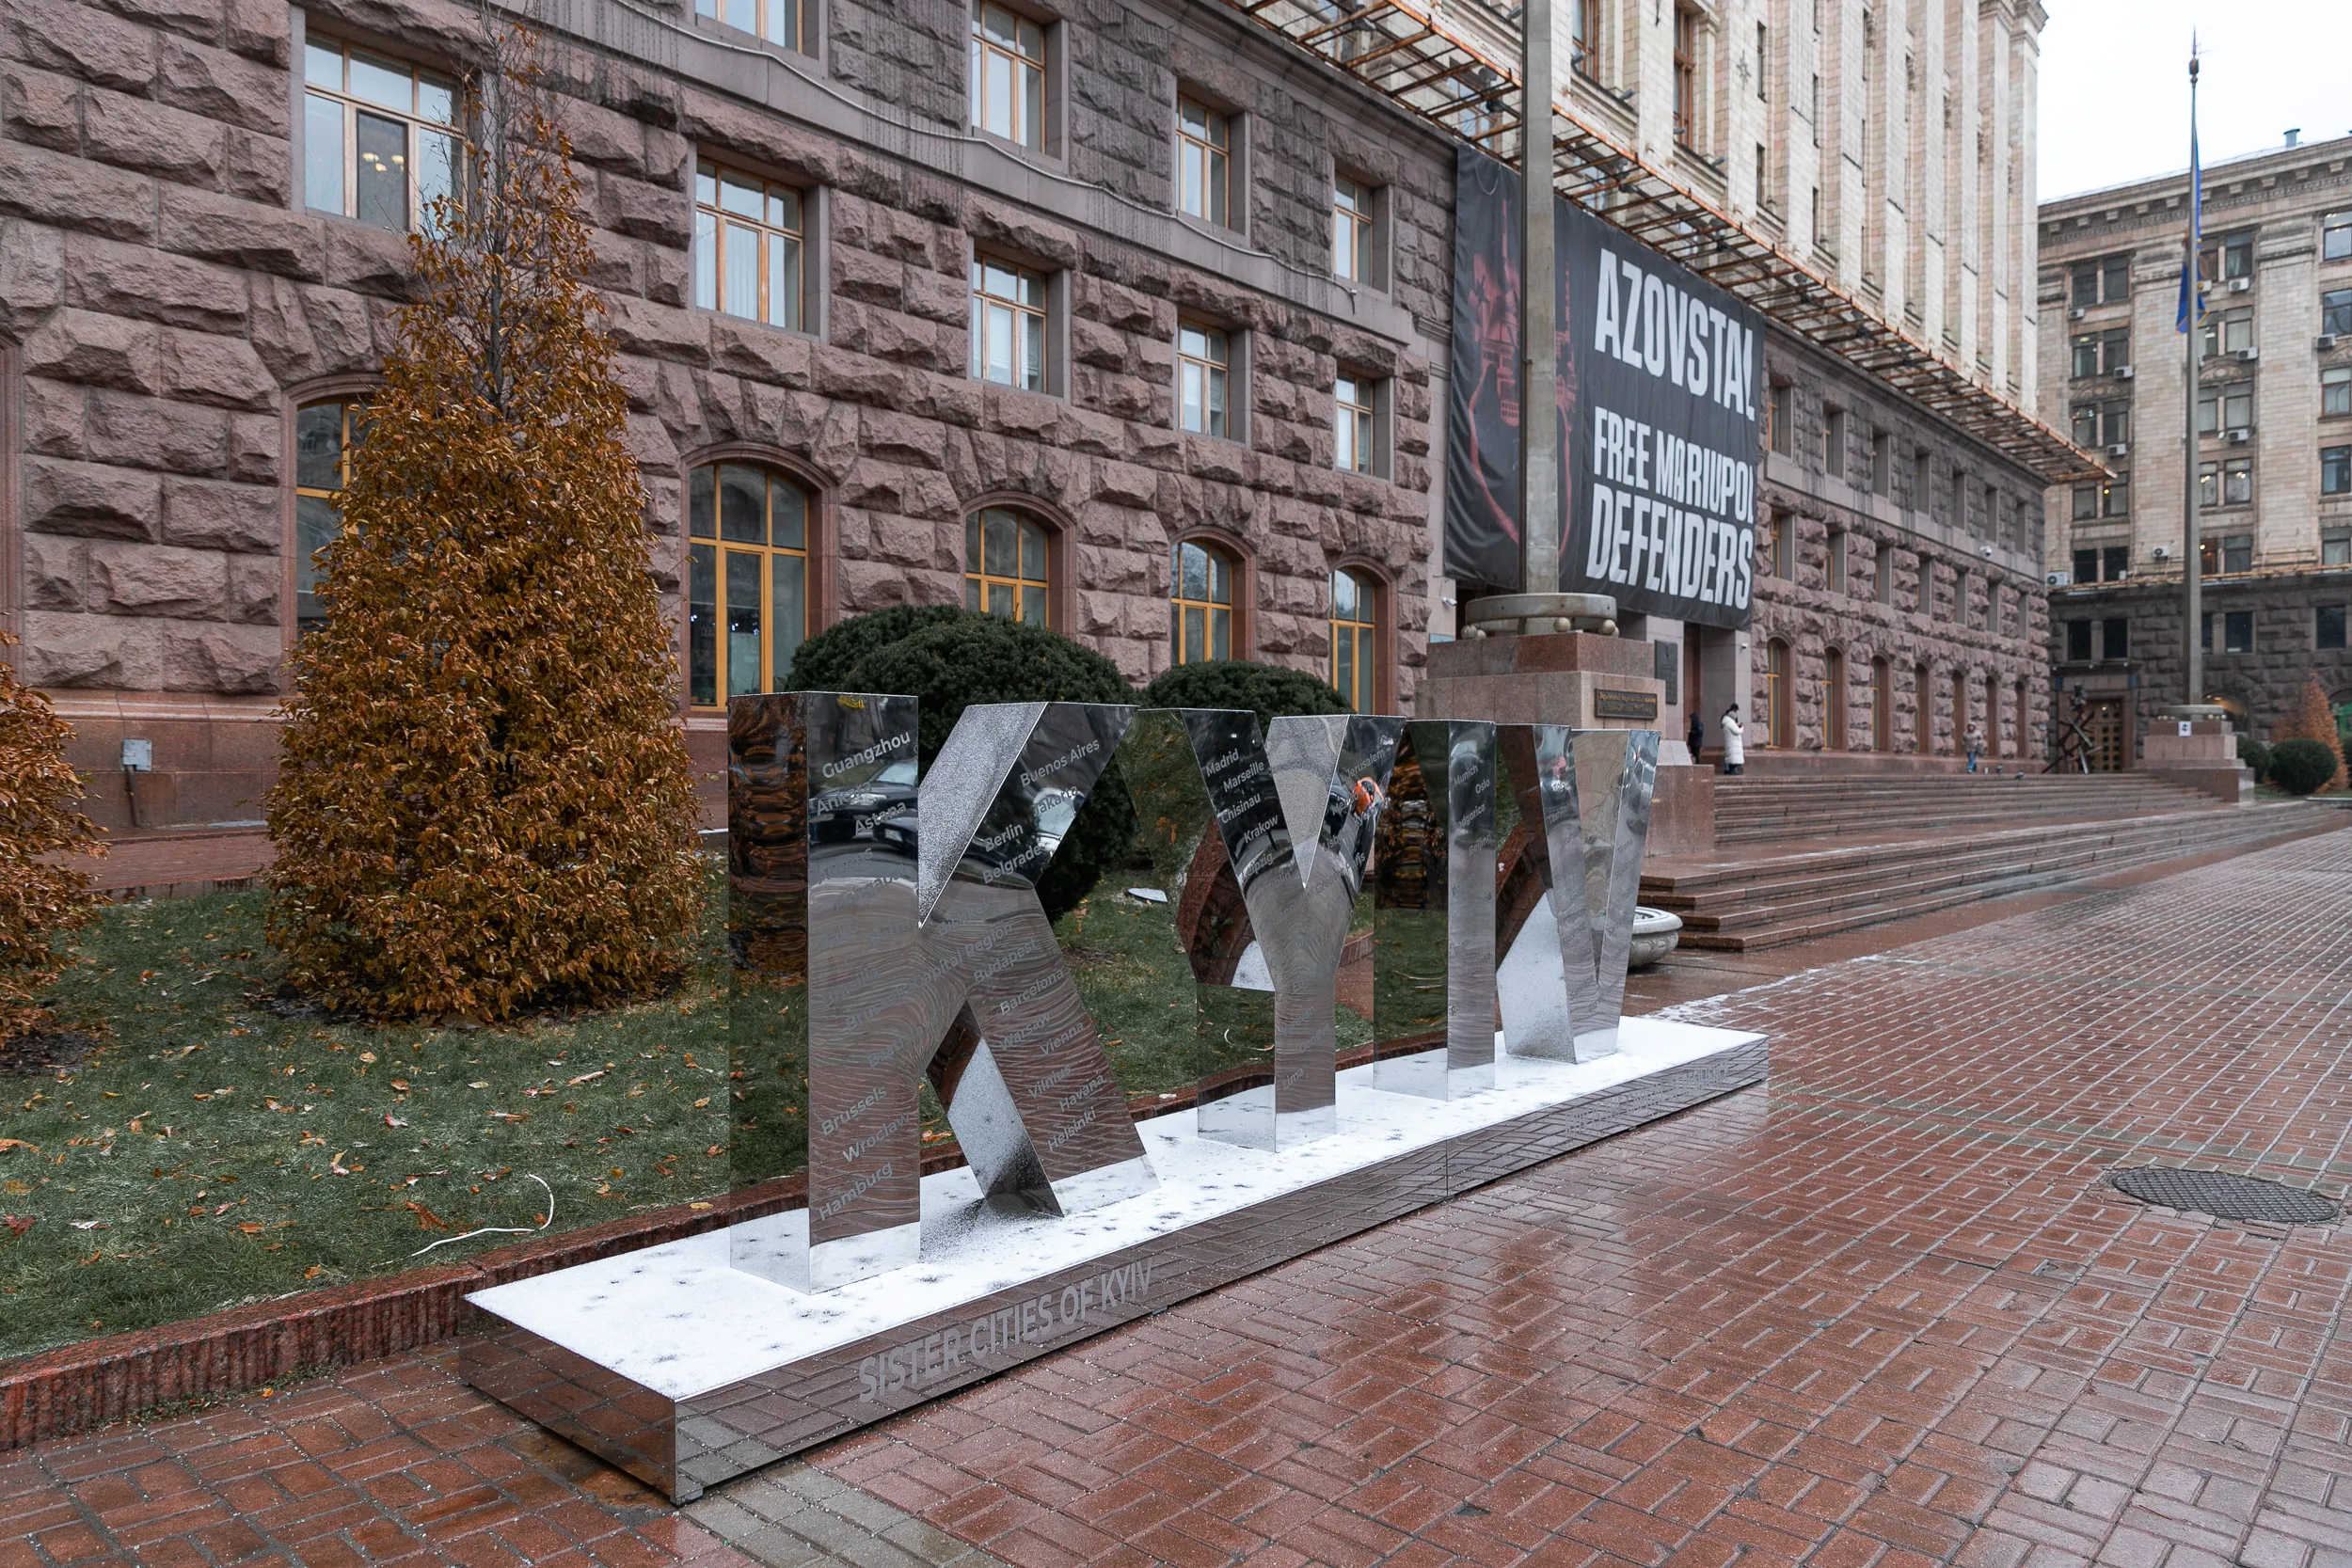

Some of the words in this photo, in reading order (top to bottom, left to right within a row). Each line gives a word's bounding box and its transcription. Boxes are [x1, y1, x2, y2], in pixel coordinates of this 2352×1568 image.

[1594, 248, 1755, 421] AZOVSTAL
[1593, 405, 1651, 489] FREE
[1655, 429, 1755, 524] MARIUPOL
[1586, 483, 1754, 610] DEFENDERS
[821, 731, 911, 780] Guangzhou
[1019, 756, 1068, 788] Buenos
[1069, 738, 1101, 764] Aires
[1205, 747, 1240, 778] Madrid
[1454, 763, 1479, 787] Munich
[1223, 760, 1265, 793] Marseille
[1474, 779, 1491, 795] Oslo
[817, 780, 873, 816] Ankara
[855, 800, 907, 836] Astana
[1220, 791, 1262, 825] Chisinau
[984, 822, 1025, 853] Berlin
[1244, 815, 1279, 844] Krakow
[981, 844, 1042, 885] Belgrade
[965, 923, 1014, 958] Region
[973, 938, 1039, 987] Budapest
[999, 968, 1064, 1017] Barcelona
[998, 1011, 1052, 1053] Warsaw
[1039, 1022, 1085, 1056] Vienna
[1027, 1064, 1073, 1100] Vilnius
[1058, 1073, 1104, 1114] Havana
[1281, 1067, 1305, 1091] Lima
[820, 1085, 888, 1137] Brussels
[1046, 1106, 1098, 1152] Helsinki
[842, 1111, 911, 1164] Wroclaw
[818, 1162, 894, 1223] Hamburg
[859, 1328, 961, 1402] SISTER
[970, 1293, 1053, 1361] CITIES
[1060, 1280, 1094, 1325] OF
[1102, 1257, 1153, 1312] KYIV
